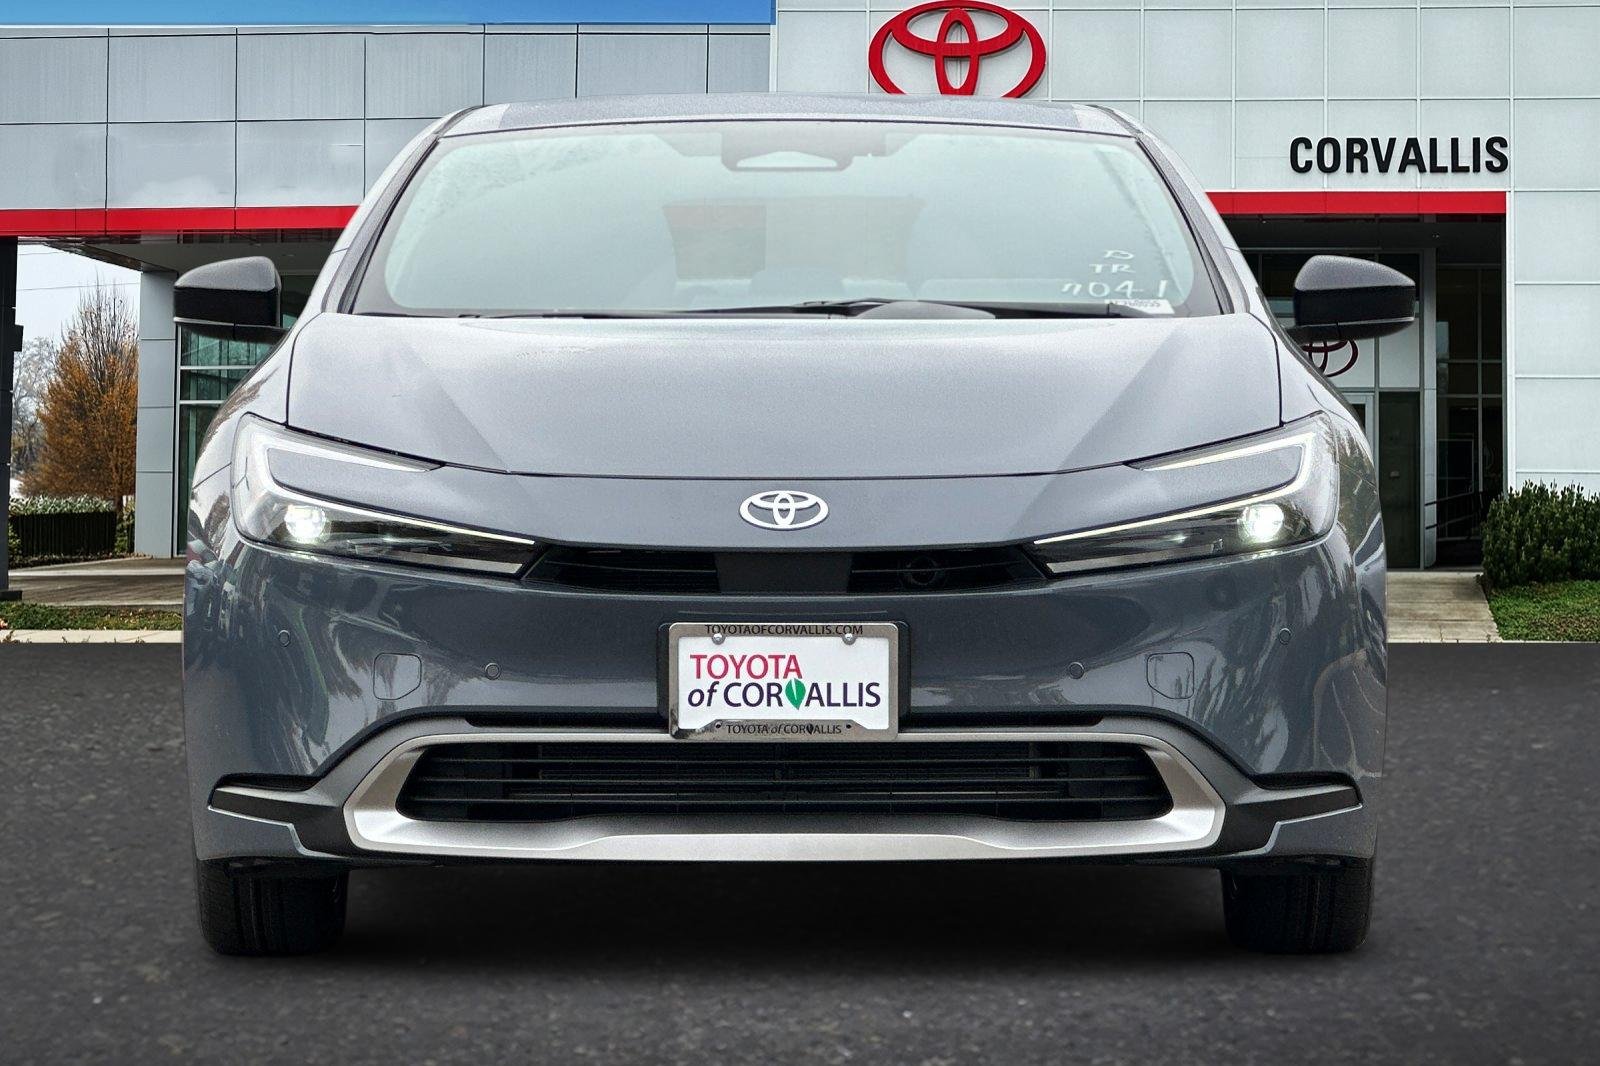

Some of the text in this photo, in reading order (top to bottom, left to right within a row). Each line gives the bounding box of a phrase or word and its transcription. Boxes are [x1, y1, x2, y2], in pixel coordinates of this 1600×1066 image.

[1290, 136, 1509, 173] CORVALLIS
[705, 624, 863, 635] TOYOTAOFCORVALLIS.COM
[690, 654, 803, 680] TOYOTA
[687, 681, 720, 708] of
[726, 724, 768, 734] TOYOTA
[770, 724, 783, 735] of
